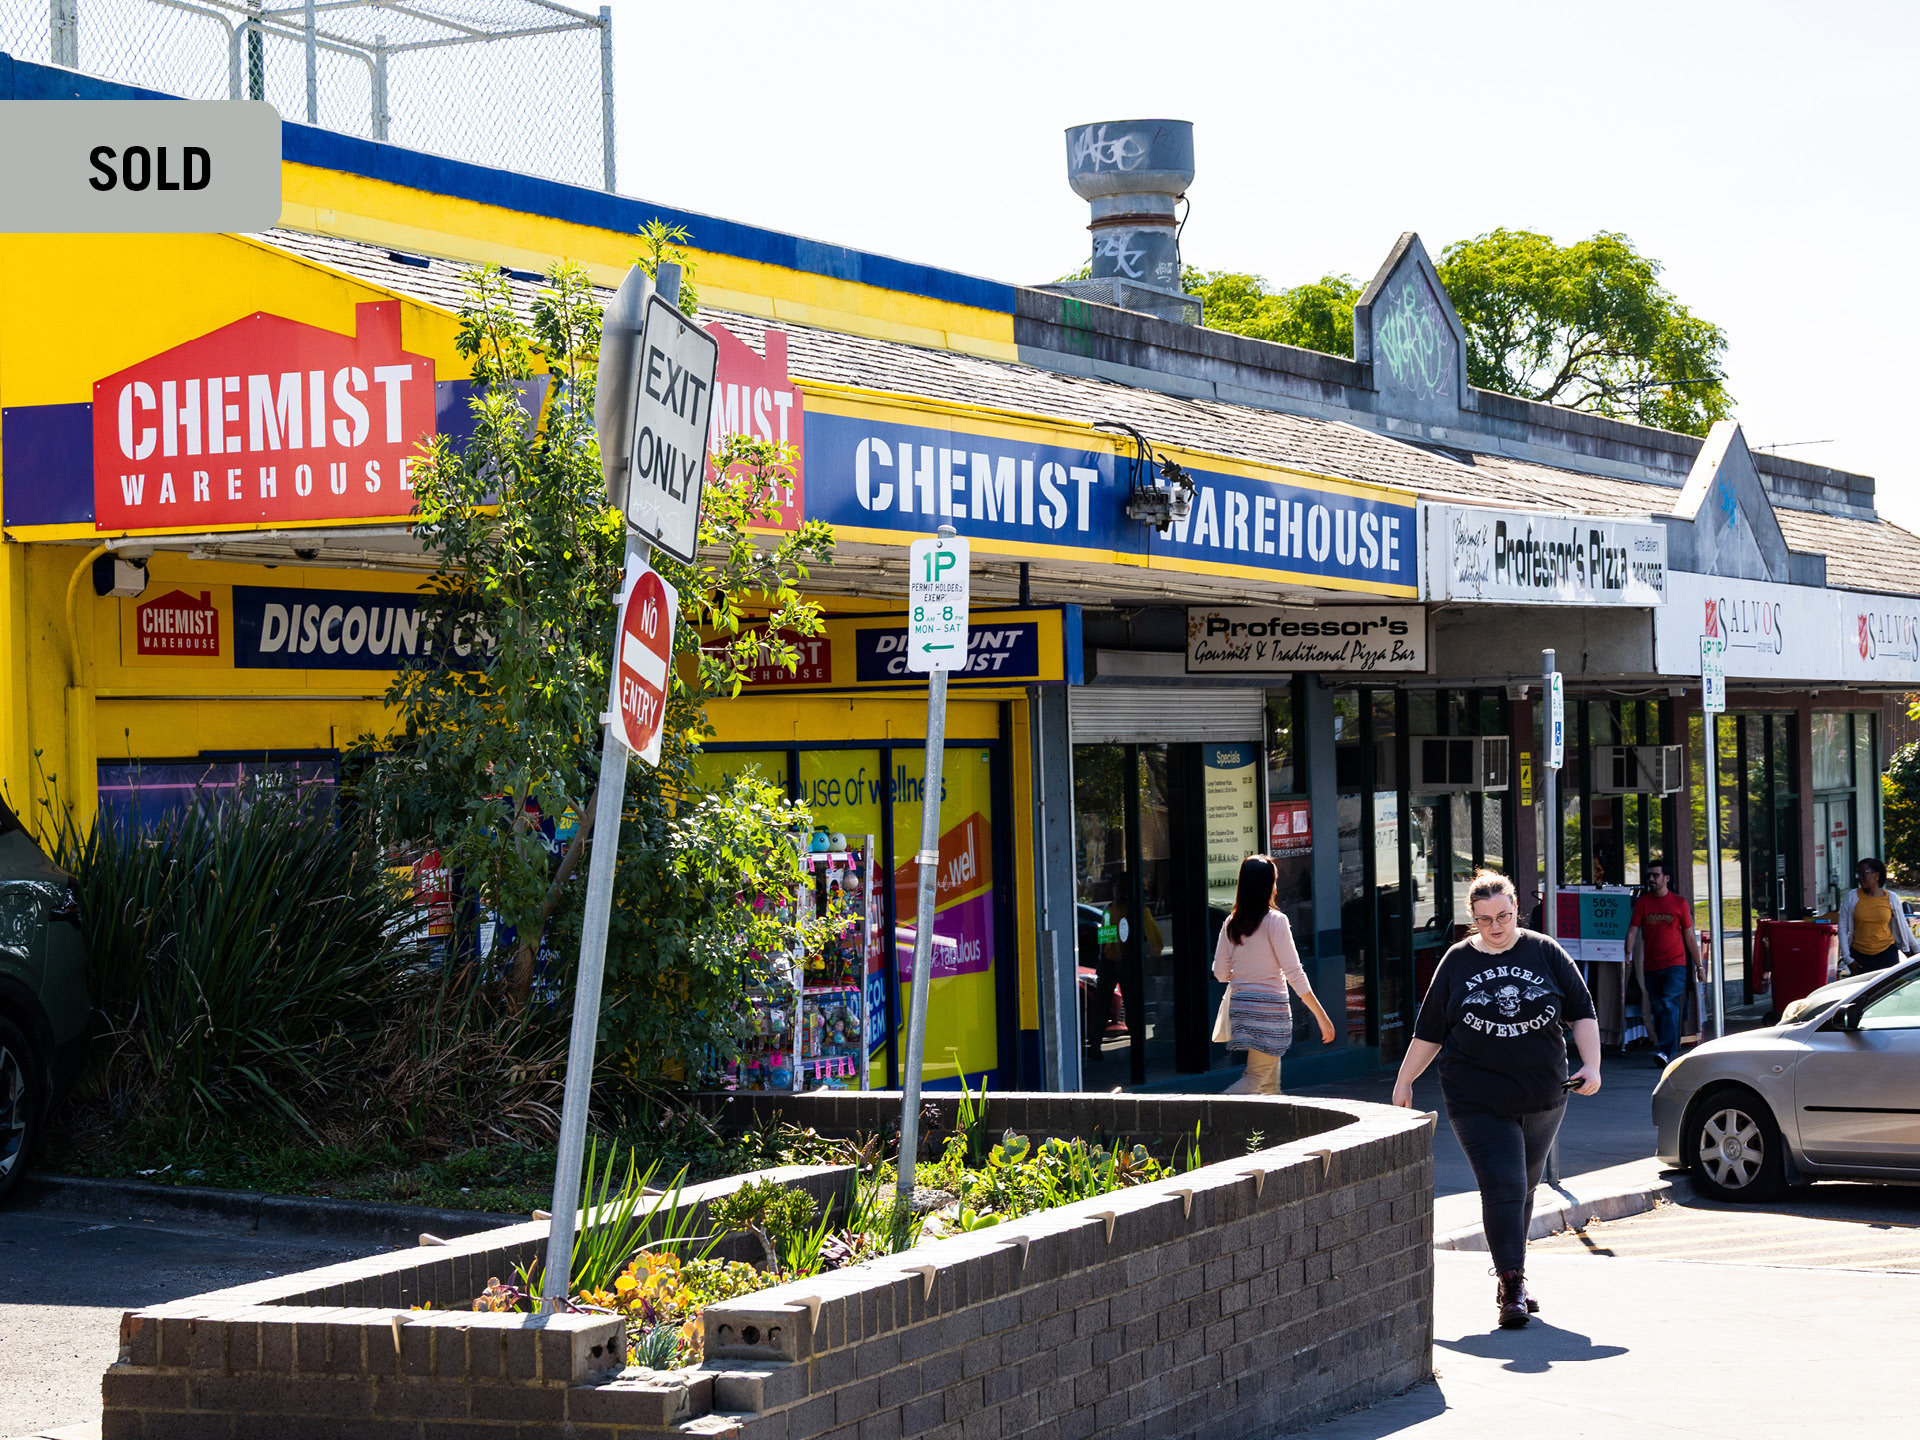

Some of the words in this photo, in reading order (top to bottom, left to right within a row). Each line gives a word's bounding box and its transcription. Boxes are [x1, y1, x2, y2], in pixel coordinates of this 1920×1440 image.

[645, 343, 707, 426] EXIT
[117, 364, 413, 461] CHEMIST
[710, 381, 794, 463] MIST
[121, 459, 414, 507] WAREHOUSE
[637, 425, 697, 505] ONLY
[855, 437, 1098, 532] CHEMIST
[923, 551, 957, 582] 1P
[1495, 520, 1585, 588] Professor's
[1589, 530, 1628, 589] Pizza
[911, 583, 934, 592] PERMIT
[935, 583, 963, 592] HOLDERS
[924, 593, 948, 602] EXEMP
[142, 607, 214, 635] CHEMIST
[259, 603, 443, 655] DISCOUNT
[641, 599, 658, 639] NO
[915, 625, 934, 634] MON
[944, 624, 961, 633] SAT
[1206, 616, 1409, 637] Professor's
[1718, 597, 1783, 655] SALVOS
[143, 637, 215, 649] WAREHOUSE
[1194, 640, 1252, 665] Gourmet
[1270, 640, 1350, 662] Traditional
[1350, 640, 1387, 670] Pizza
[1389, 640, 1416, 662] Bar
[1868, 612, 1919, 663] SALVOS
[623, 677, 657, 729] ENTRY
[1216, 750, 1241, 767] Specials
[846, 767, 866, 807] of
[949, 822, 976, 887] well
[1593, 898, 1618, 909] 50%
[1594, 909, 1617, 918] OFF
[1561, 922, 1576, 934] $2
[1465, 966, 1545, 991] AVENGED
[1463, 1005, 1556, 1037] SEVENFOLD
